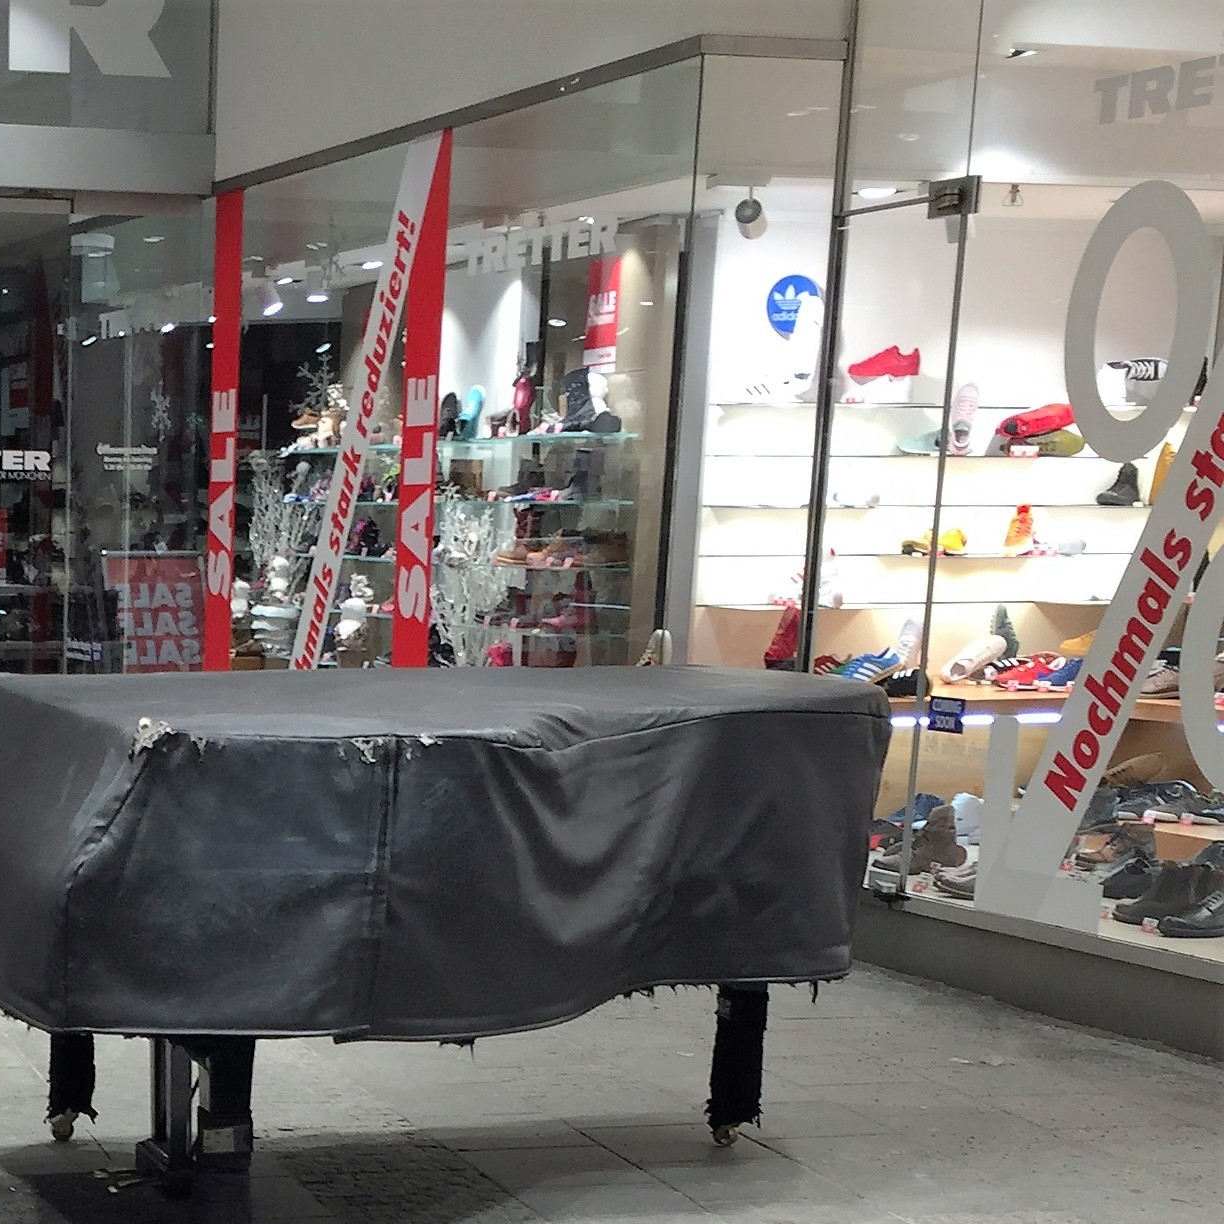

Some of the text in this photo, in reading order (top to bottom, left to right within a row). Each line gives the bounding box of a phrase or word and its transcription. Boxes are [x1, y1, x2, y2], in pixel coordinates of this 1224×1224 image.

[1093, 53, 1224, 126] TRE
[207, 387, 238, 600] SALE
[329, 446, 362, 557] stark
[355, 210, 417, 438] reduziert!
[397, 374, 436, 624] SALE
[1042, 528, 1193, 812] Nochmals
